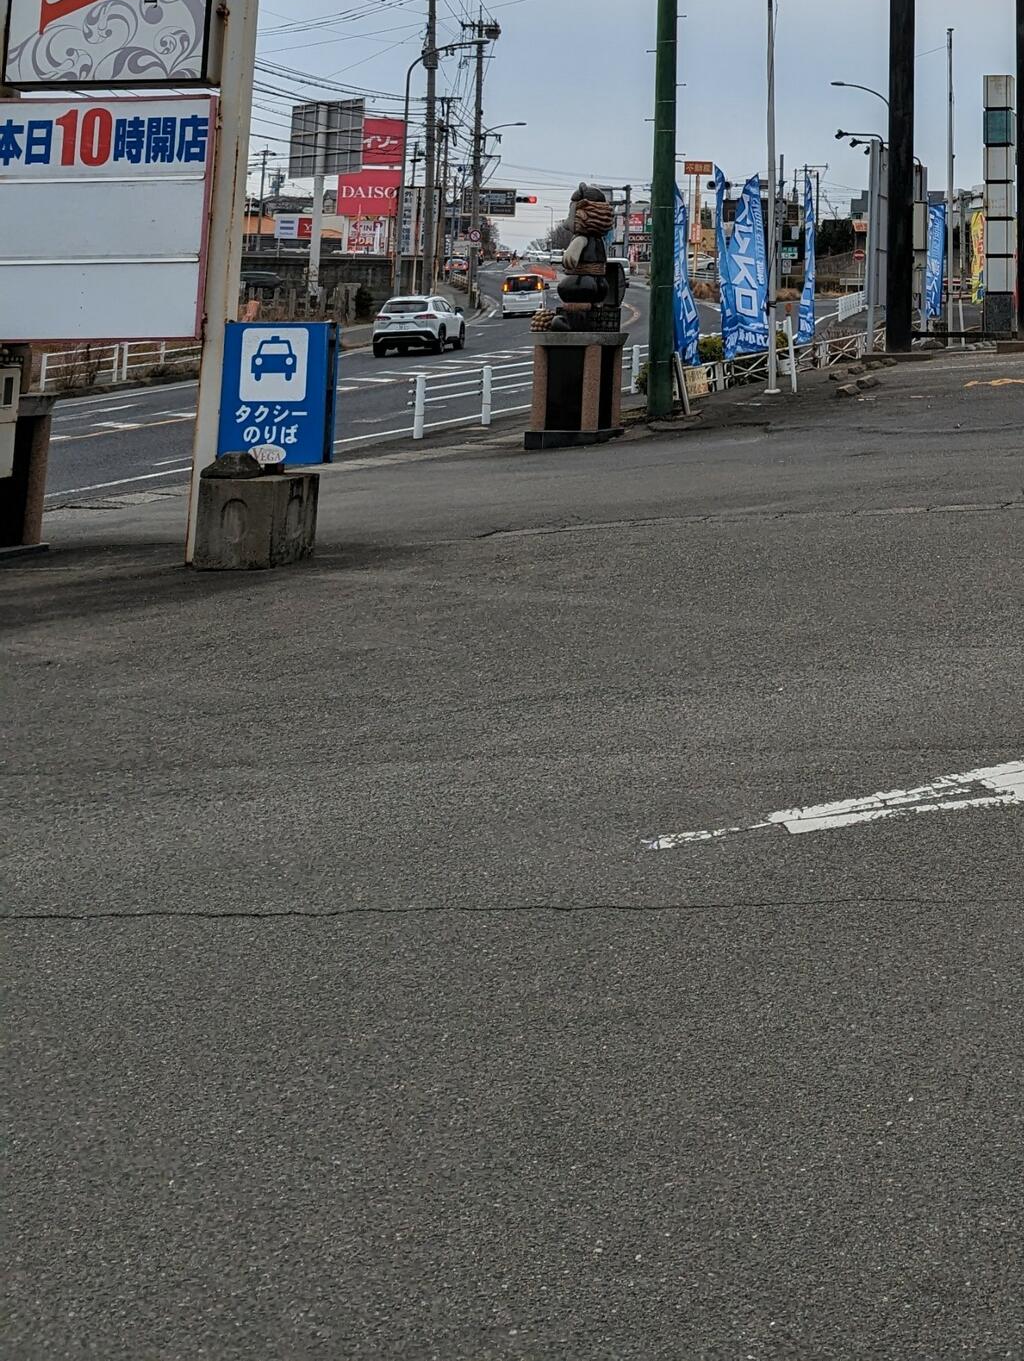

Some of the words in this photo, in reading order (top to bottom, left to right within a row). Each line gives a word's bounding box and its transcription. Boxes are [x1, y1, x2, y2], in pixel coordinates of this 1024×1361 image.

[0, 106, 208, 167] 本日10時開店
[342, 185, 397, 199] DAISO
[235, 404, 308, 424] タクシー
[243, 424, 299, 444] のりば
[252, 447, 282, 462] VEGA
